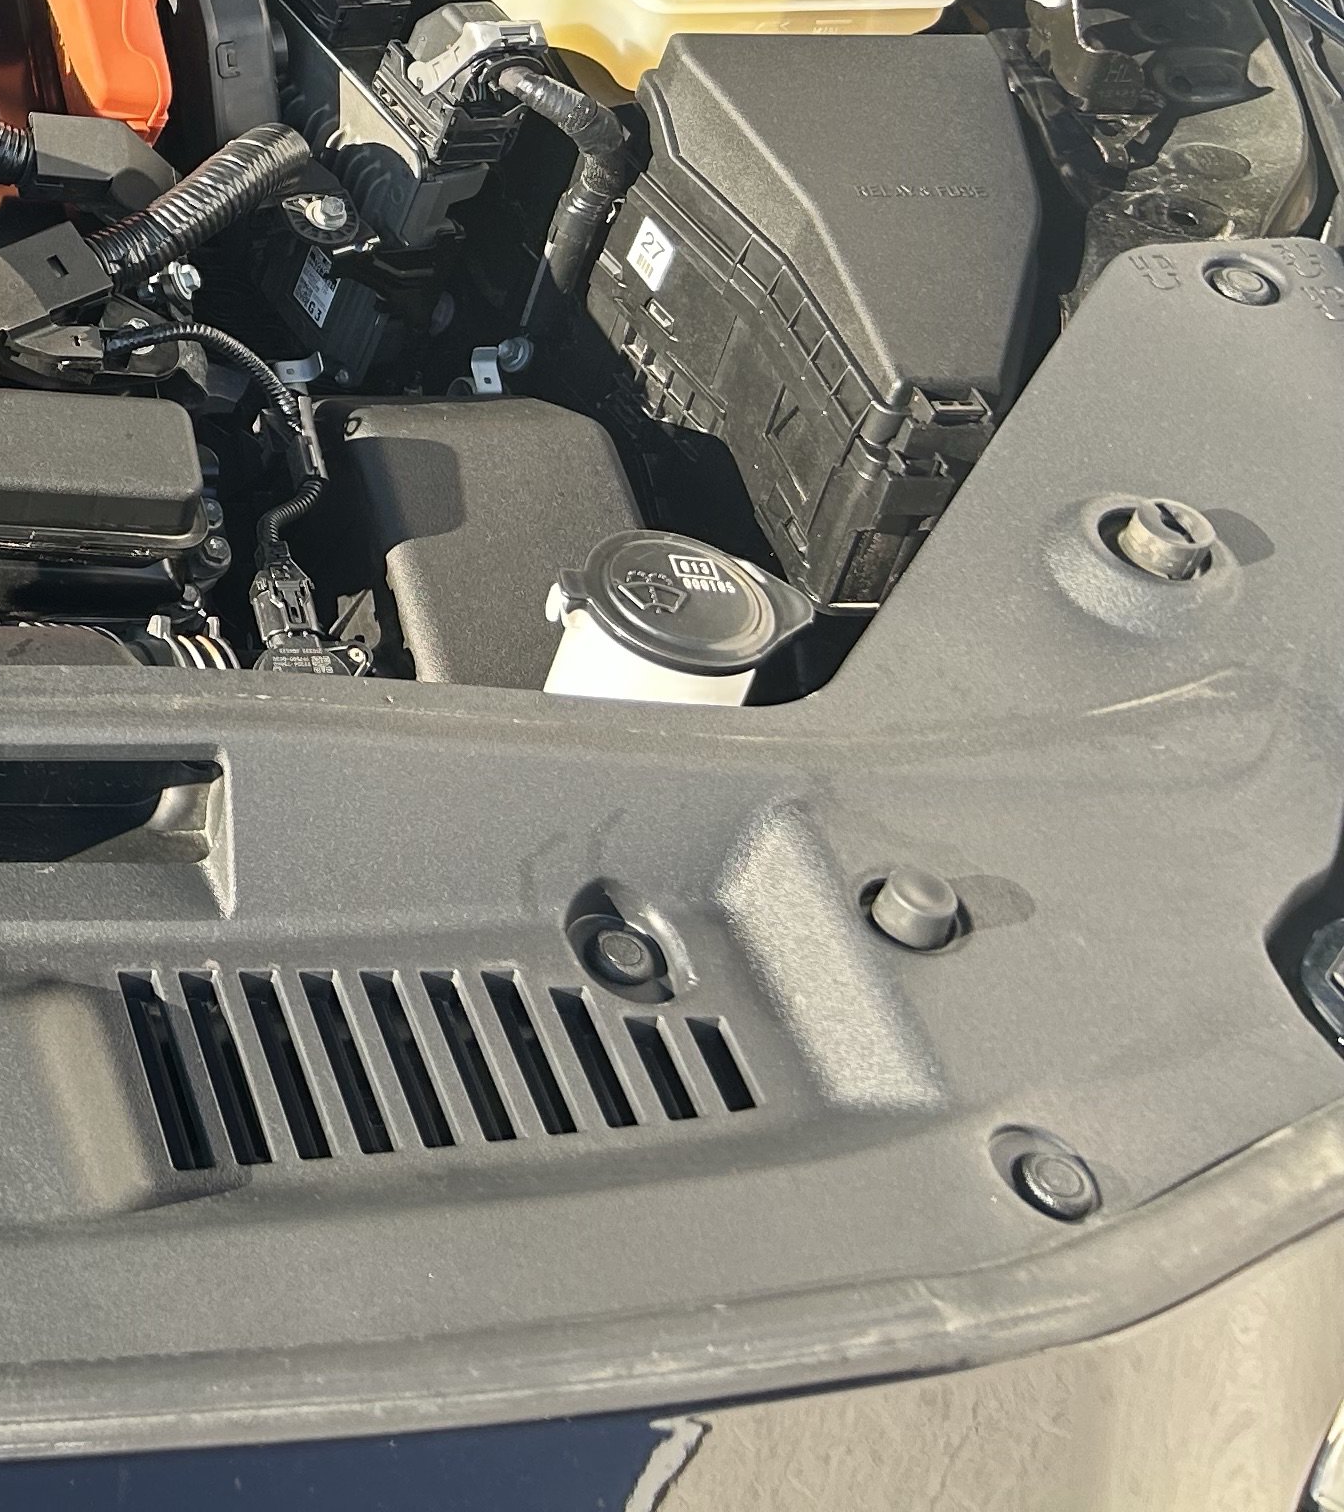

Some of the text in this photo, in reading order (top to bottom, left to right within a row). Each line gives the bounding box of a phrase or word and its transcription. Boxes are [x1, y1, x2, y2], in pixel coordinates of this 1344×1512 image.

[853, 184, 914, 198] RELAY
[935, 184, 988, 198] FUSE
[640, 231, 666, 260] 27
